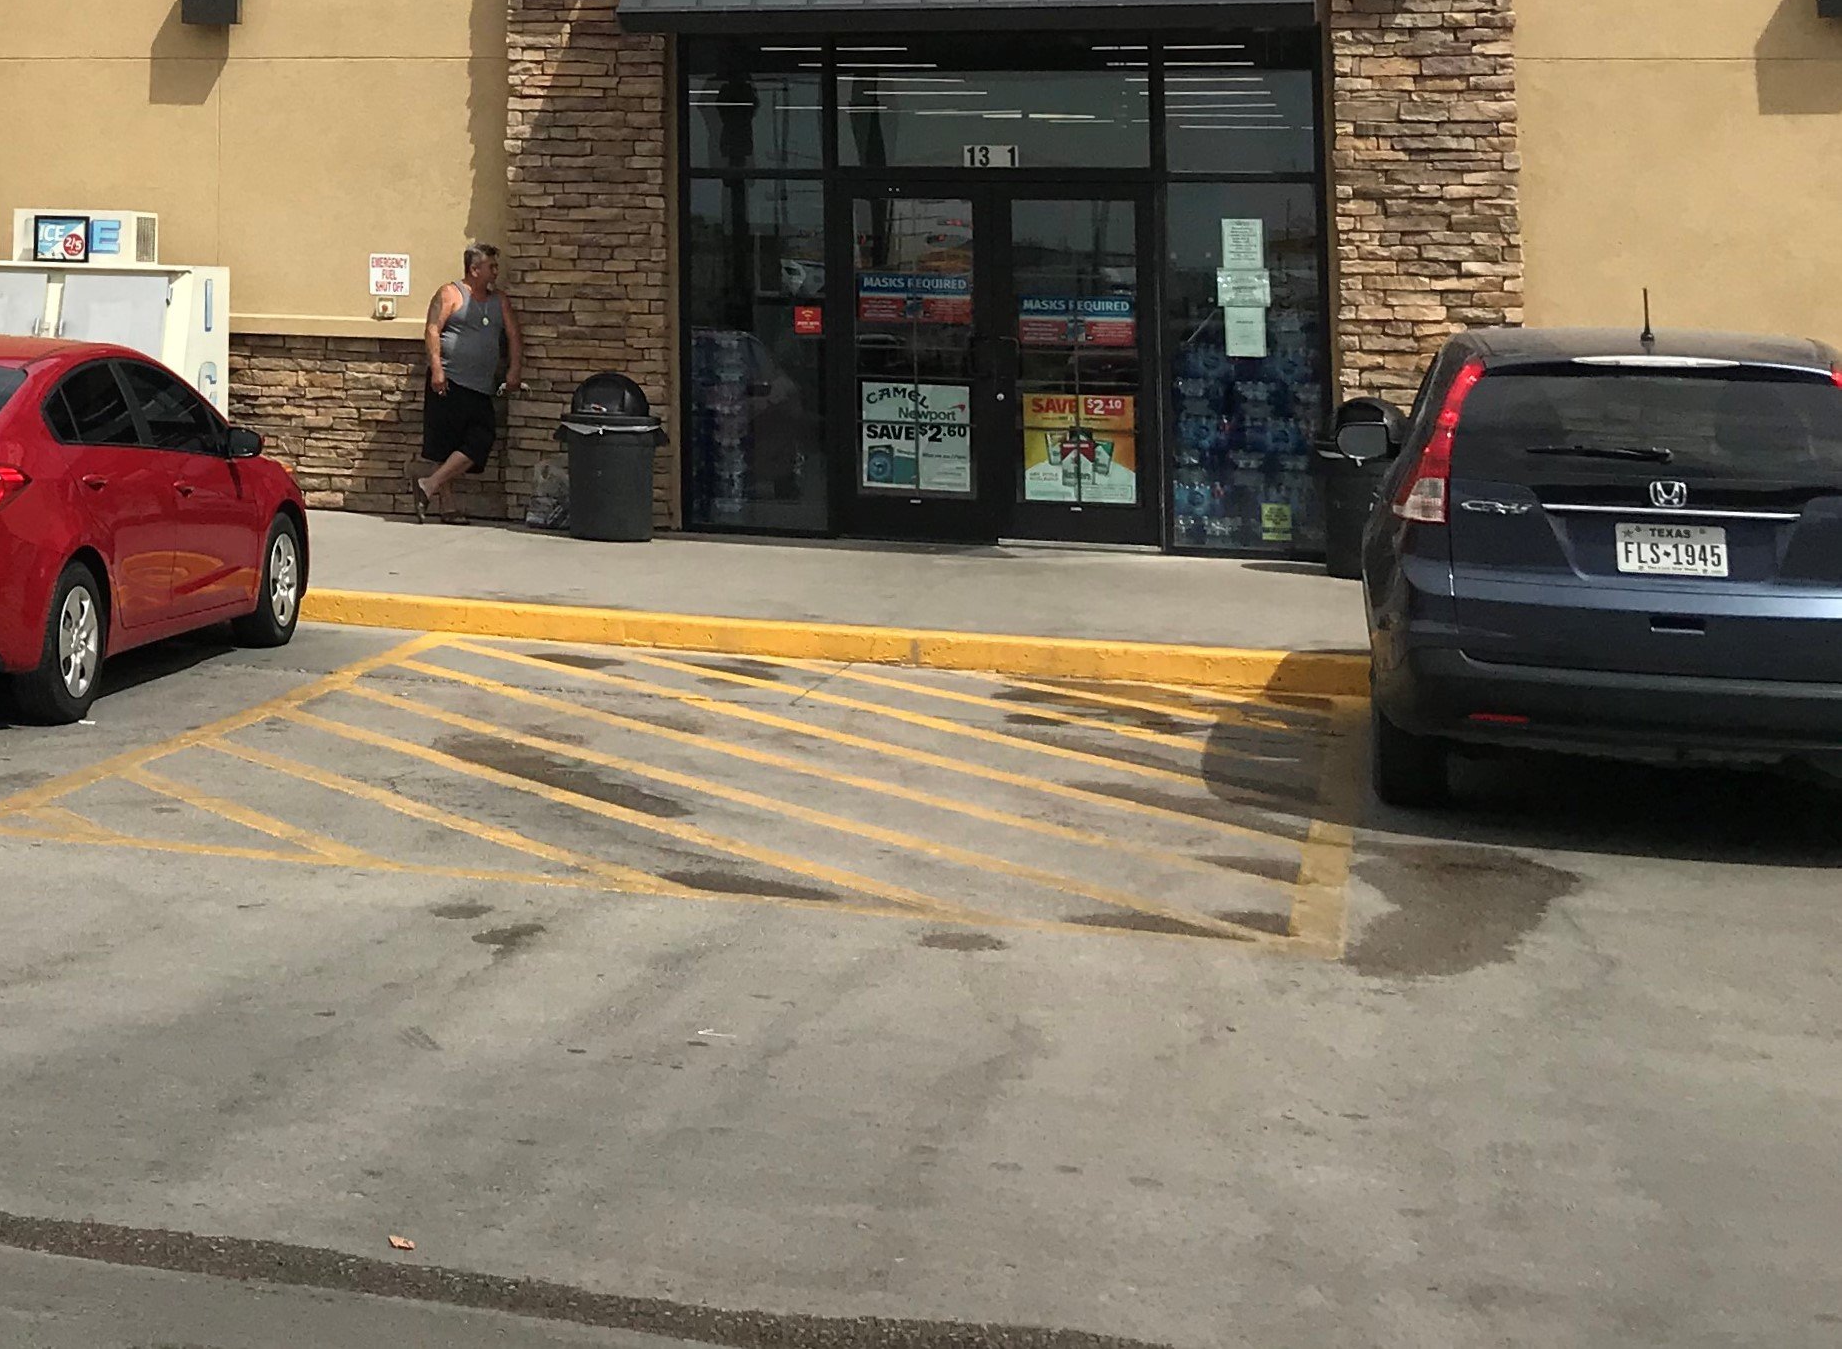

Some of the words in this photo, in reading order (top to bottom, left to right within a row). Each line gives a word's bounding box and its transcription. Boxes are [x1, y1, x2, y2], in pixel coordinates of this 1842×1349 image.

[39, 224, 65, 242] ICE
[371, 257, 407, 269] EMERGENCY
[381, 268, 398, 281] FUEL
[375, 280, 392, 292] SHUT
[392, 281, 405, 293] OFF
[863, 277, 905, 288] MASKS
[1022, 298, 1066, 311] MASKS
[866, 386, 930, 410] CAMEL
[1031, 396, 1078, 414] SAVE
[1086, 398, 1122, 415] $2.10
[898, 406, 957, 423] Newport
[866, 423, 917, 441] SAVE
[918, 423, 967, 443] $2.60
[1648, 527, 1691, 540] TEXAS
